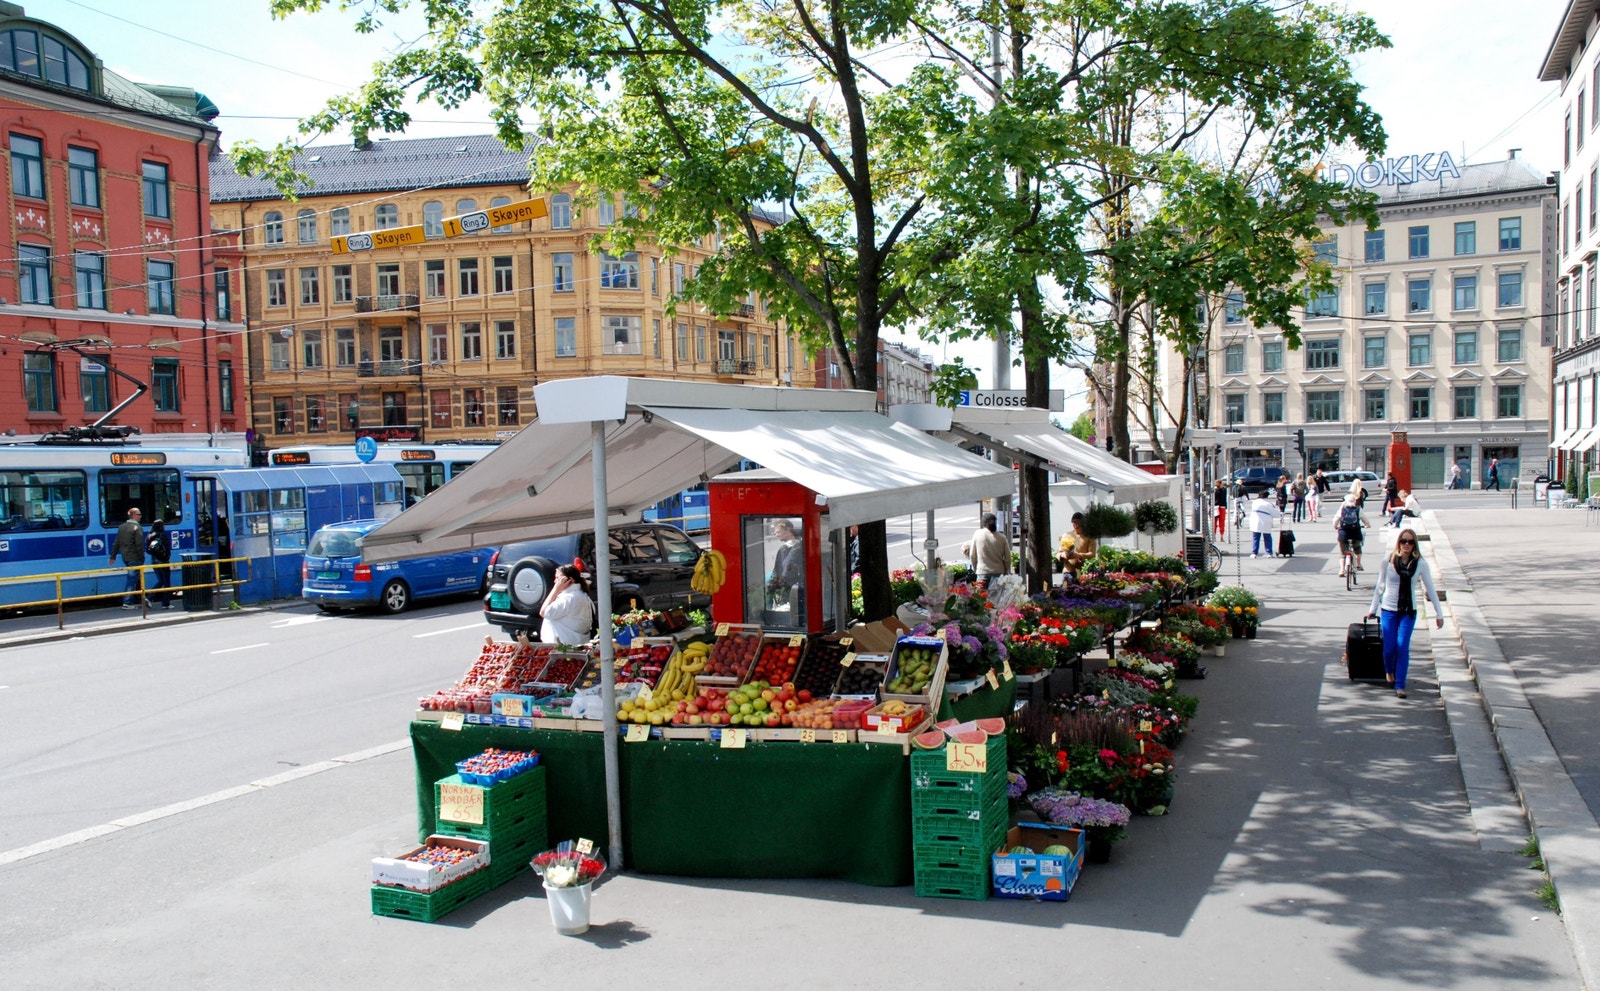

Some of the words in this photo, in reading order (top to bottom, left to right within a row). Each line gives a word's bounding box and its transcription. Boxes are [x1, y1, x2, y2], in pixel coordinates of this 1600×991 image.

[1329, 151, 1460, 190] DOKKA
[463, 218, 480, 229] Ring
[479, 215, 487, 226] 2
[492, 205, 532, 223] Skøyen
[349, 239, 365, 248] Ring
[364, 237, 371, 247] 2
[376, 231, 412, 245] Skøyen
[975, 393, 1027, 407] Colosse
[357, 441, 367, 453] 10
[111, 453, 121, 464] 19
[634, 725, 643, 739] 3
[728, 728, 737, 747] 3
[802, 730, 813, 742] 25
[834, 731, 846, 741] 30
[953, 744, 975, 767] 15
[452, 805, 474, 821] 65
